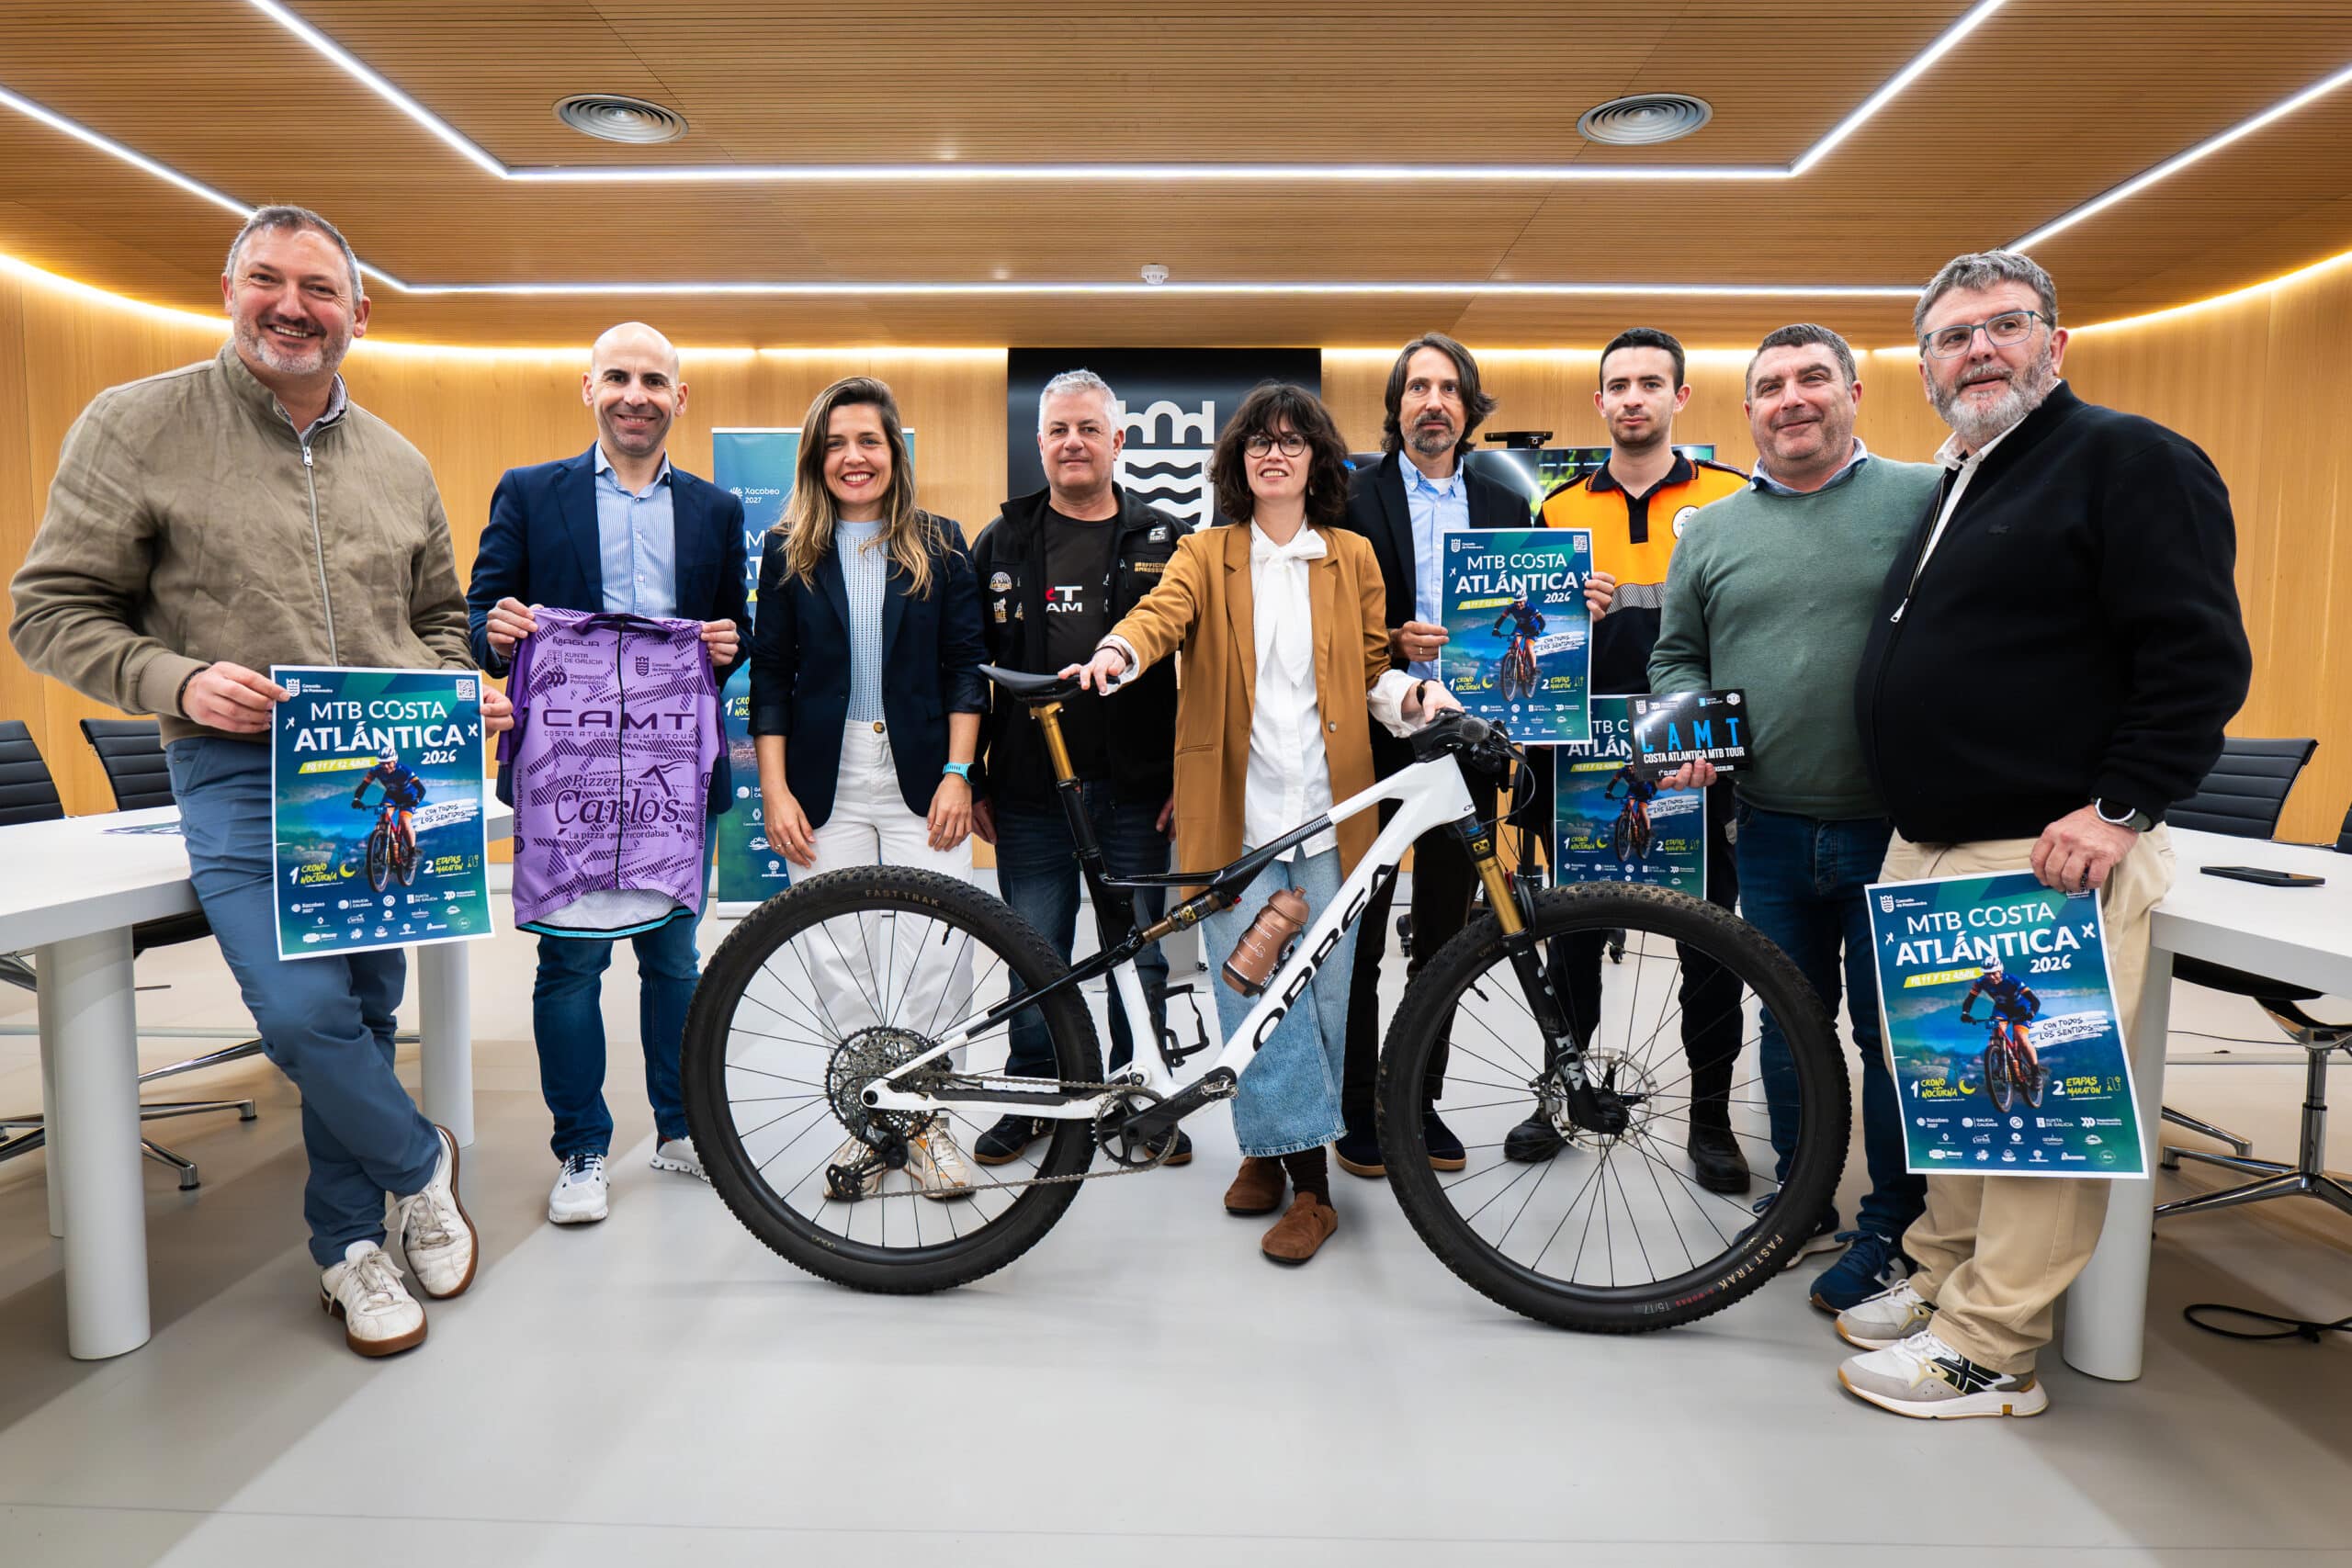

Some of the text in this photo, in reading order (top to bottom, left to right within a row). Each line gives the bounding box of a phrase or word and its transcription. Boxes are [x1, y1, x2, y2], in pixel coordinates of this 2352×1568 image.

[745, 487, 780, 495] Xacobeo
[1467, 553, 1567, 570] MTB COSTA
[1454, 570, 1578, 594] ATLÁNTICA
[1544, 591, 1571, 604] 2026
[1541, 679, 1549, 689] 2
[726, 698, 733, 716] 1
[736, 696, 750, 705] CRO
[311, 700, 447, 721] MTB COSTA
[542, 709, 695, 730] CAMT
[1592, 720, 1613, 734] TB
[294, 721, 466, 752] ATLÁNTICA
[421, 750, 457, 764] 2026
[1644, 747, 1745, 763] COSTA ATLANTICA MTB TOUR
[555, 787, 681, 825] Carlos
[421, 816, 435, 824] LOS
[569, 831, 579, 840] La
[581, 830, 605, 840] pizza
[1656, 841, 1664, 852] 2
[435, 854, 462, 865] ETAPAS
[300, 863, 327, 873] CRONO
[424, 860, 435, 874] 2
[289, 867, 299, 885] 1
[300, 872, 337, 885] NOCTURNA
[865, 889, 898, 897] FAST
[1906, 901, 2056, 935] MTB COSTA
[1895, 925, 2081, 966] ATLÁNTICA
[2030, 954, 2072, 974] 2026
[2043, 1017, 2084, 1031] CON TODOS
[2040, 1024, 2094, 1040] LOS SENTIDOS
[1920, 1077, 1946, 1088] CRONO
[2052, 1079, 2065, 1095] 2
[2065, 1076, 2098, 1087] ETAPAS
[1911, 1080, 1918, 1098] 1
[1921, 1087, 1958, 1099] NOCTURNA
[1755, 1234, 1783, 1265] FAST
[1718, 1262, 1756, 1291] TRAK
